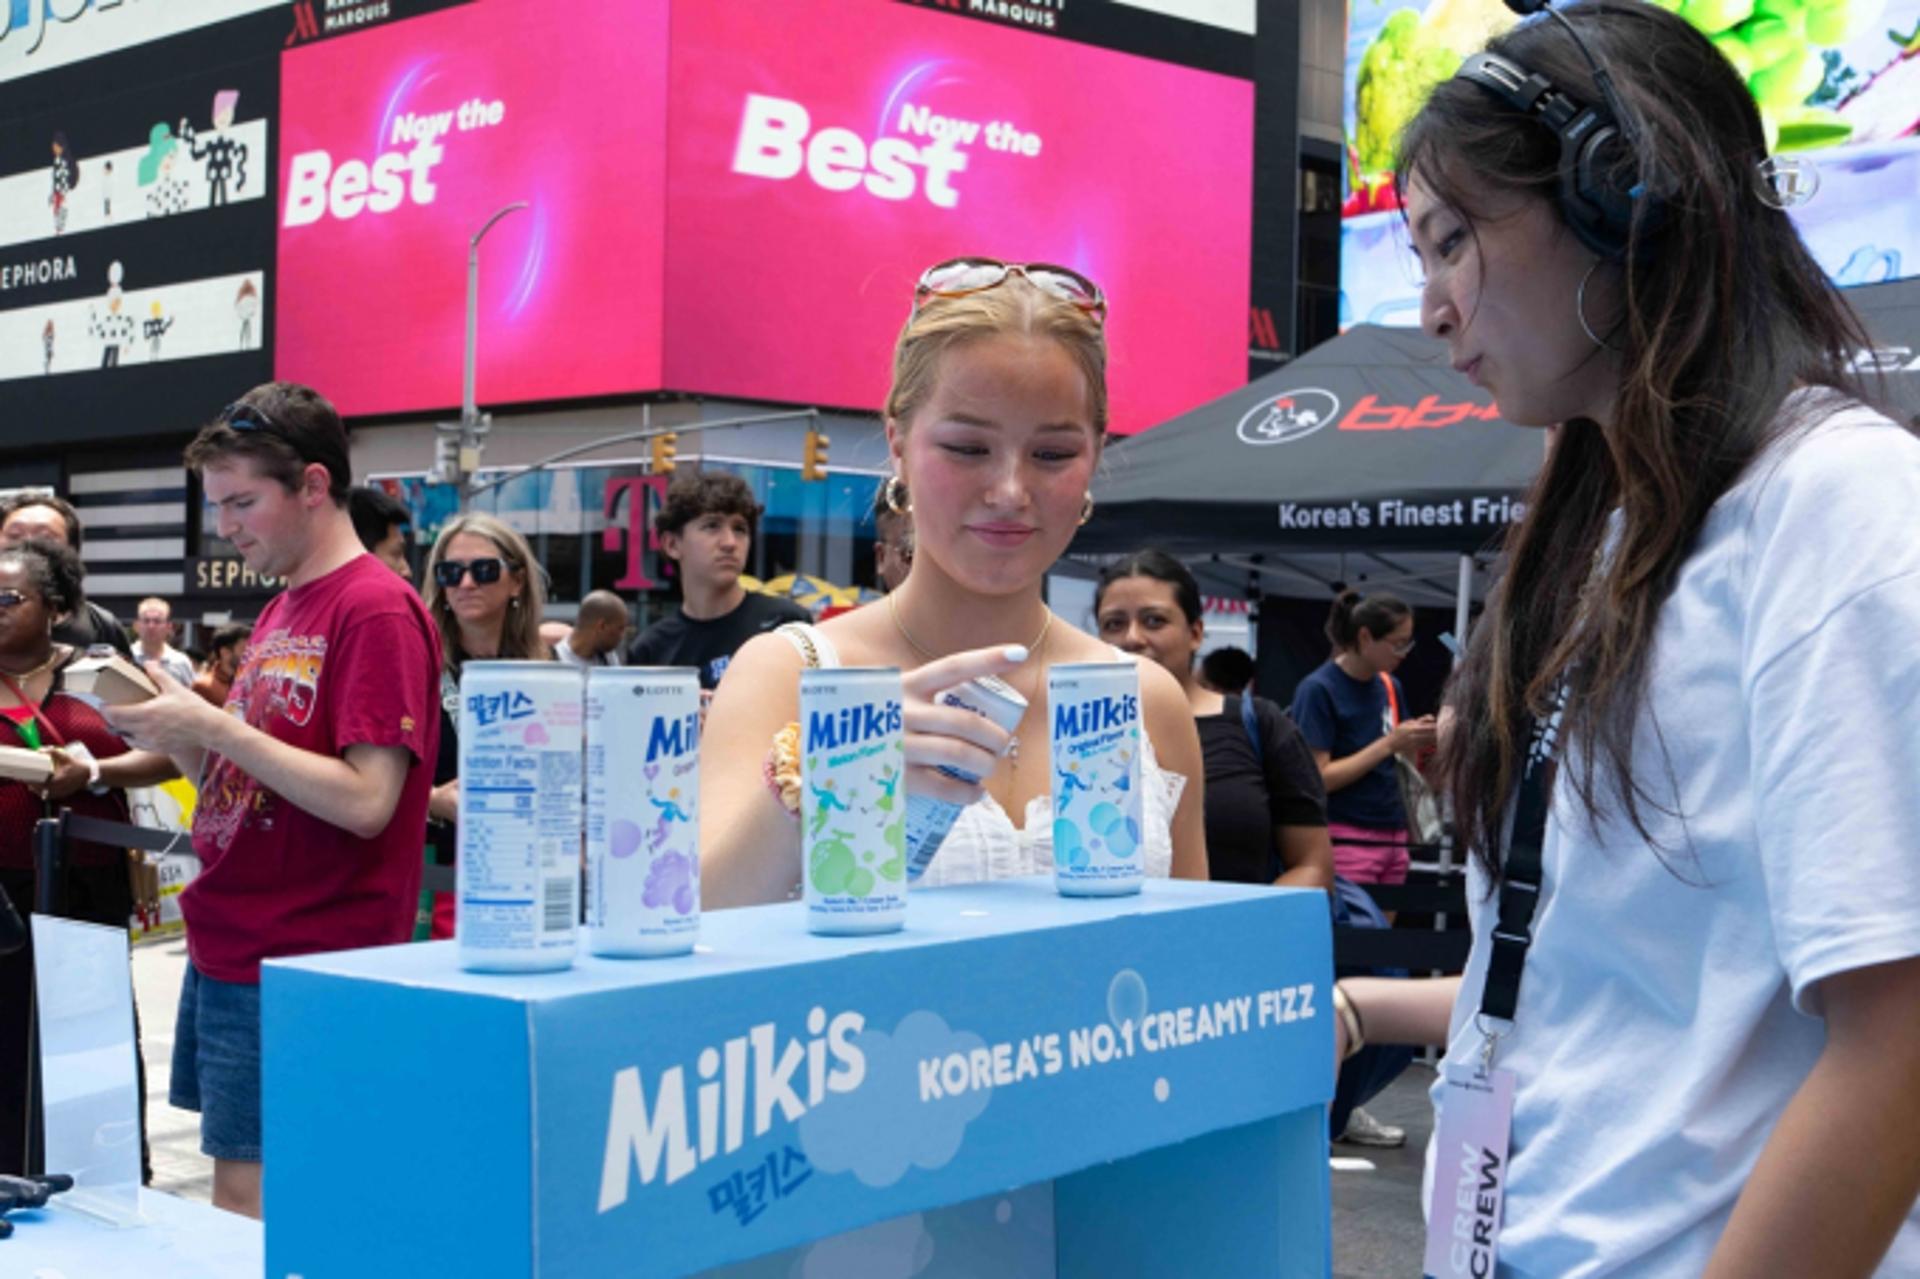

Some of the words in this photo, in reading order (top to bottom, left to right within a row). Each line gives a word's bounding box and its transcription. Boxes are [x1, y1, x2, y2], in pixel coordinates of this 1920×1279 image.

[324, 2, 390, 31] MARQUIS
[969, 0, 1056, 27] MARQUIS
[391, 112, 453, 145] Now
[457, 98, 506, 131] the
[898, 103, 981, 146] Now
[984, 121, 1042, 157] the
[731, 92, 969, 209] Best
[282, 136, 445, 229] Best
[0, 254, 77, 290] EPHORA
[1278, 502, 1371, 529] Korea's
[1378, 497, 1465, 526] Finest
[467, 690, 536, 726] 밀키스
[807, 699, 902, 754] Milkis
[1055, 693, 1137, 741] Milkis
[919, 1034, 1062, 1101] KOREA'S
[1070, 1018, 1135, 1068] NO.1
[1140, 996, 1252, 1053] CREAMY
[1259, 983, 1316, 1028] FIZZ
[598, 1005, 866, 1215] Milkis
[707, 1145, 814, 1227] 밀키스
[1451, 1141, 1480, 1275] CREW
[1469, 1147, 1500, 1279] CREW
